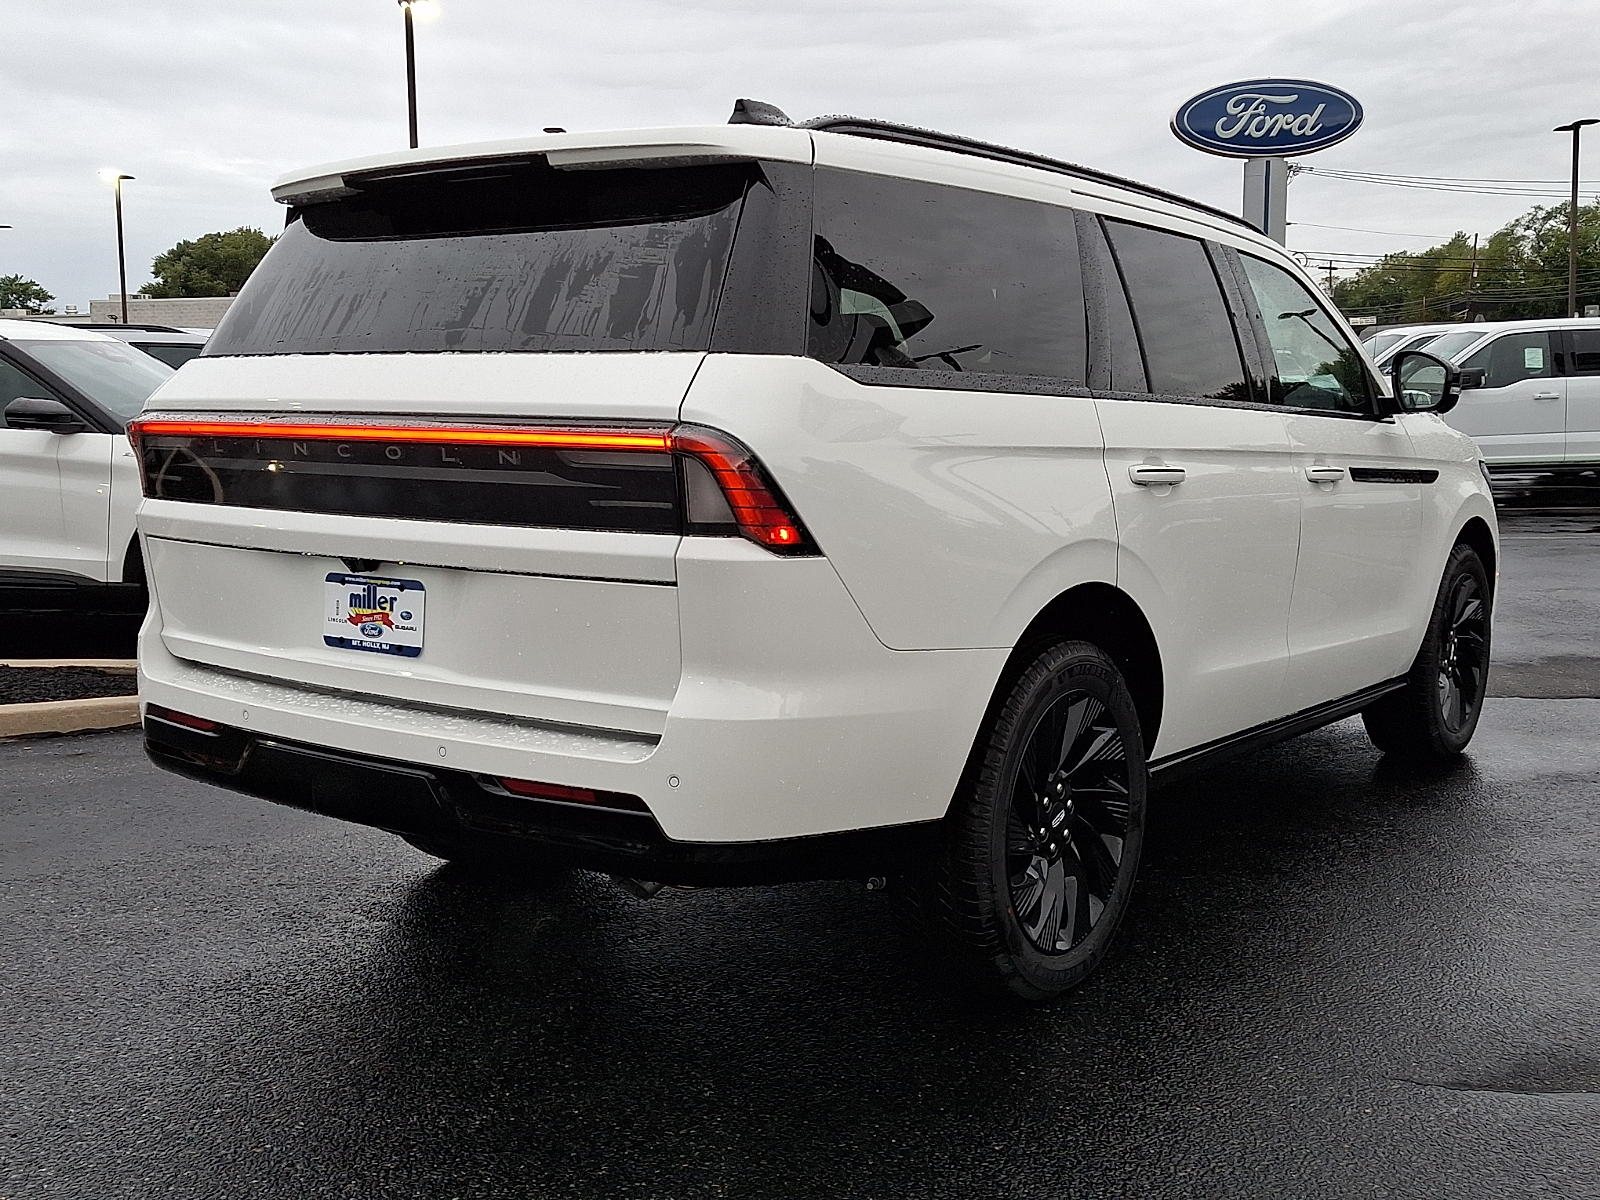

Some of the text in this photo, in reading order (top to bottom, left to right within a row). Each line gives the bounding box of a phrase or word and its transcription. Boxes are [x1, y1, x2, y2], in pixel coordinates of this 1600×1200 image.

[1215, 93, 1326, 139] Ford
[213, 439, 522, 466] LINCOLN
[349, 585, 398, 612] miller
[351, 639, 361, 647] MT.
[364, 624, 380, 637] Ford
